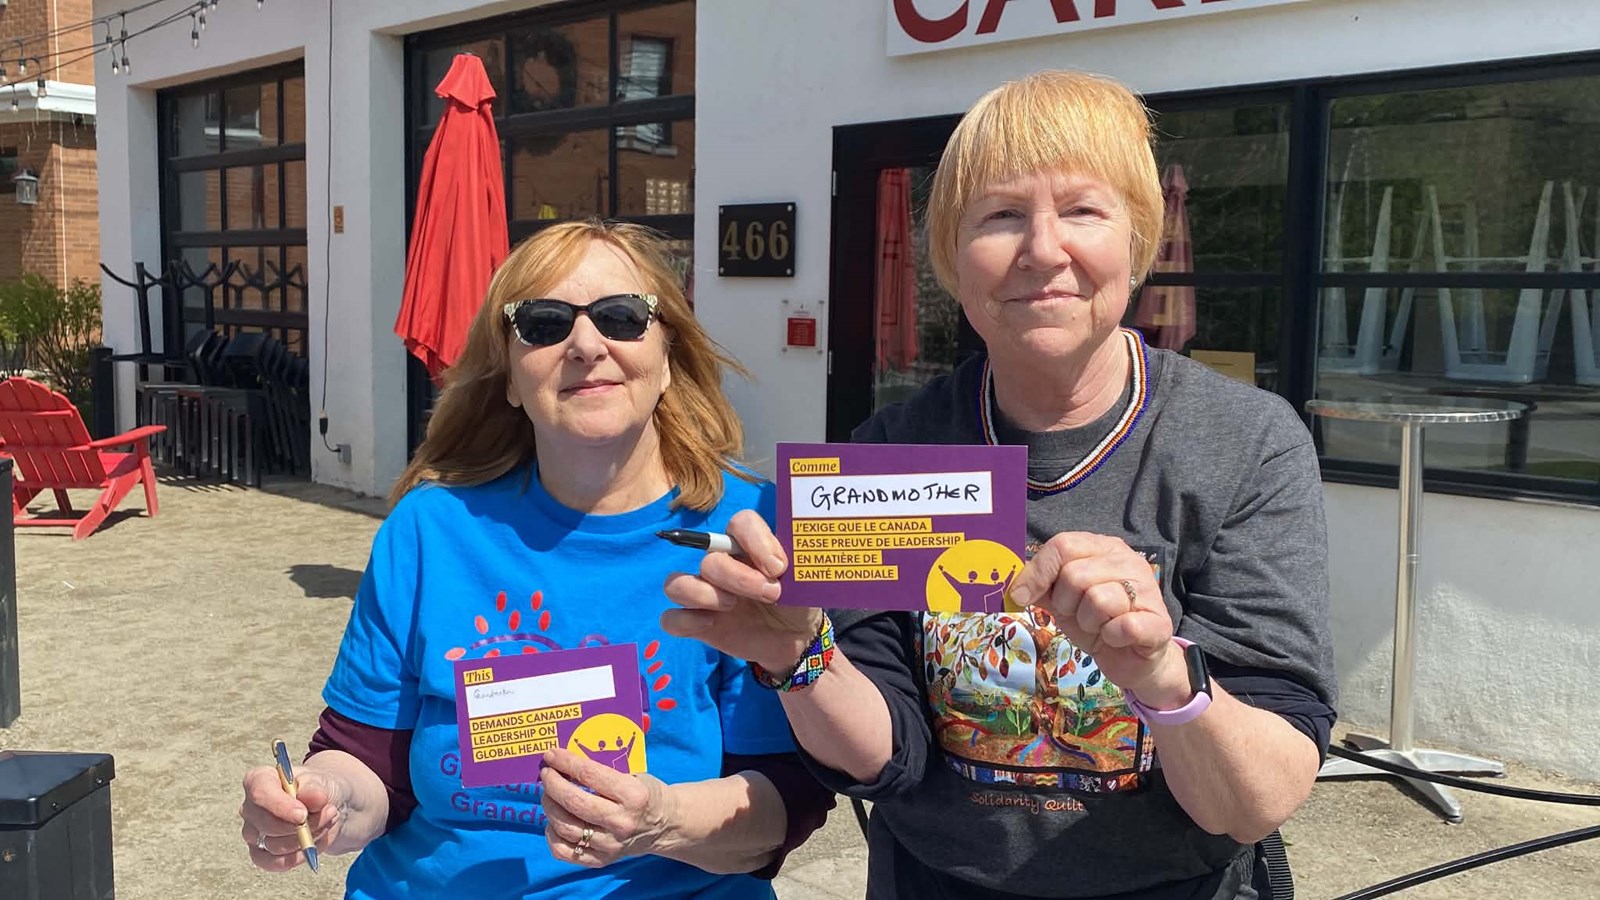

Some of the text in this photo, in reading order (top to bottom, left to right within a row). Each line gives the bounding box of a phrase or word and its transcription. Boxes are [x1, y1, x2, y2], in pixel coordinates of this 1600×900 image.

[722, 220, 789, 260] 466
[792, 461, 837, 473] Comme
[811, 483, 980, 510] GRANDMOTHER
[795, 521, 927, 533] J'EXIGE QUE LE CANADA
[796, 535, 961, 548] FASSE PREUVE DE LEADERSHIP
[797, 551, 878, 564] EN MATIÈRE DE
[798, 569, 894, 580] SANTÉ MONDIALE
[466, 670, 490, 682] This
[472, 708, 579, 730] DEMANDS CANADA'S
[474, 727, 555, 745] LEADERSHIP ON
[475, 741, 557, 760] GLOBAL HEALTH
[970, 792, 1084, 814] Solidarity Quilt
